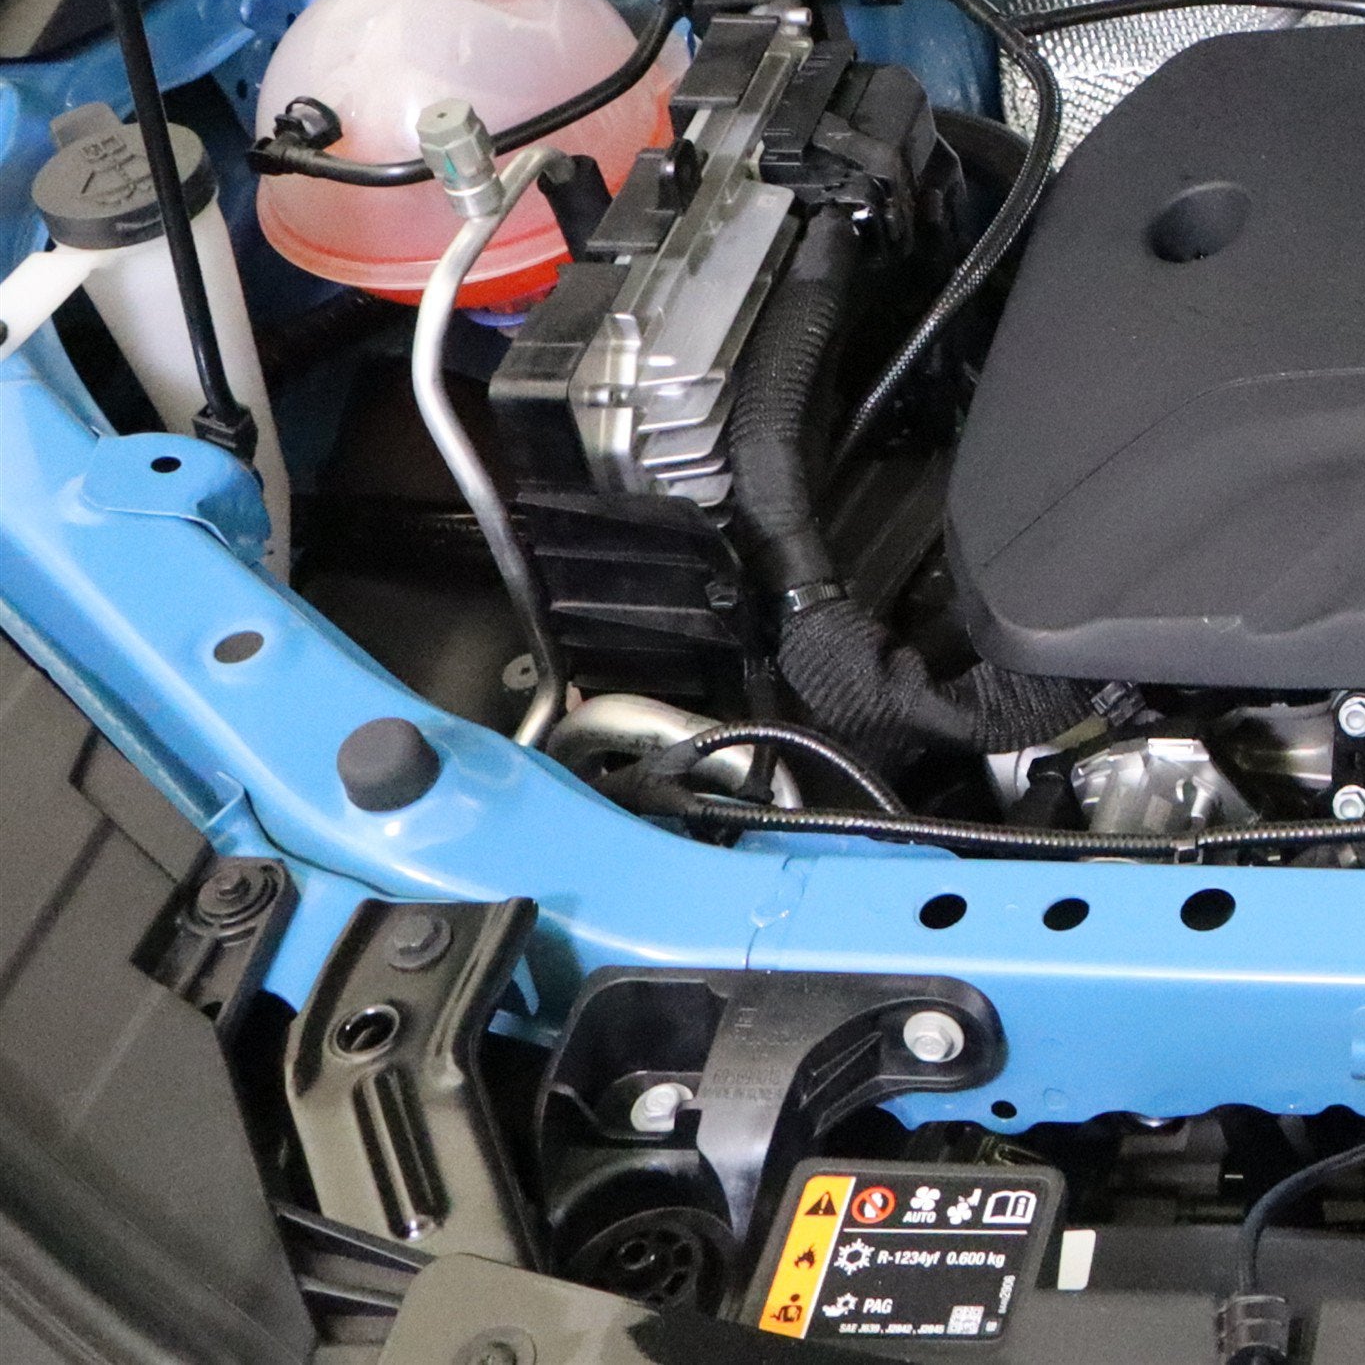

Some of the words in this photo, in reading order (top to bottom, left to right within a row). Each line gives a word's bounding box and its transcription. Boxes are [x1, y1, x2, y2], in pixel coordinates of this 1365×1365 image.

[902, 1210, 937, 1224] AUTO
[877, 1250, 939, 1267] R-1234yf
[946, 1251, 986, 1266] 0.600
[987, 1251, 1006, 1268] kg
[862, 1299, 893, 1314] PAG
